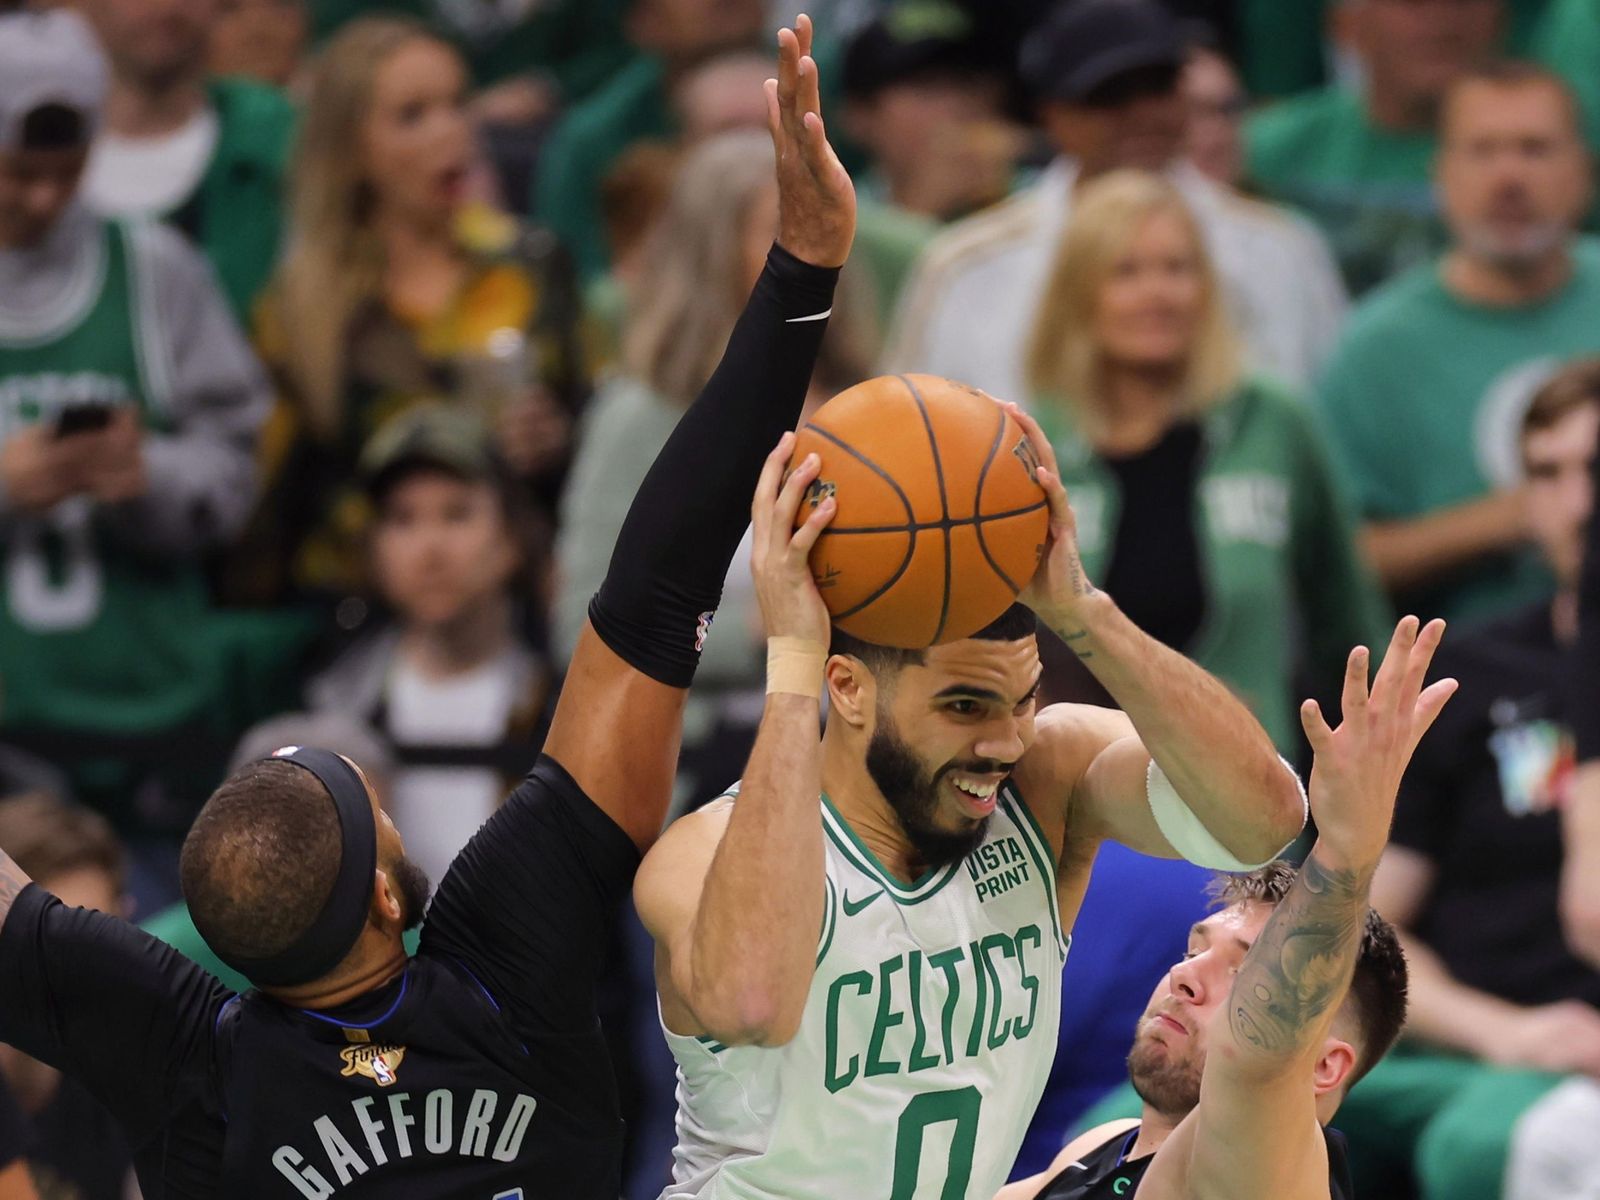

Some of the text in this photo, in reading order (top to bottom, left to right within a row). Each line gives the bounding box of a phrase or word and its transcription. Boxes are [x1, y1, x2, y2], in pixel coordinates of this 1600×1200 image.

[965, 837, 1025, 882] VISTA
[975, 862, 1029, 903] PRINT
[824, 924, 1041, 1094] CELTICS
